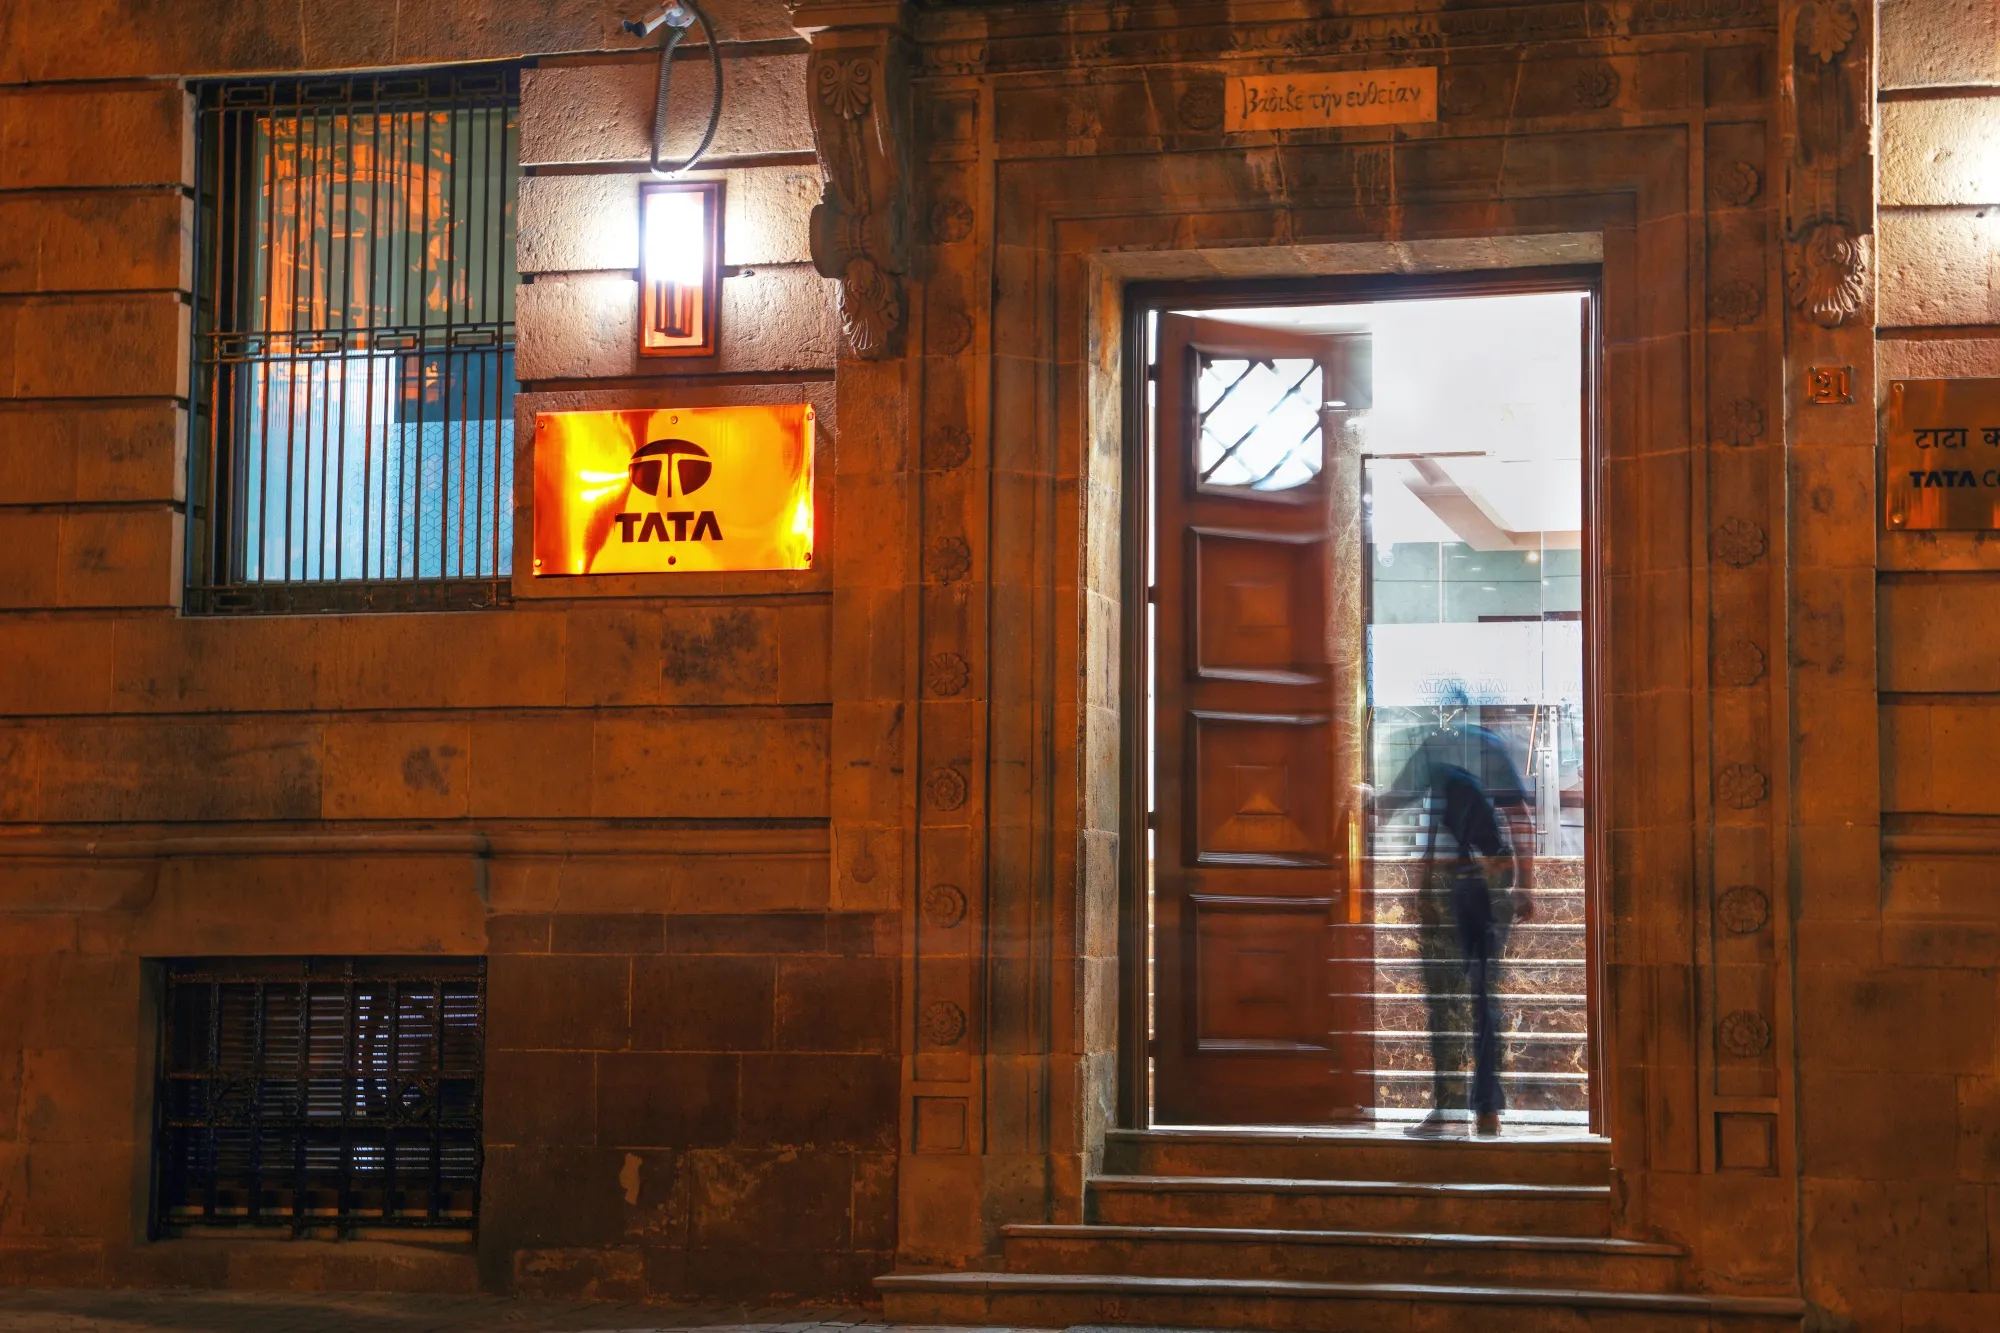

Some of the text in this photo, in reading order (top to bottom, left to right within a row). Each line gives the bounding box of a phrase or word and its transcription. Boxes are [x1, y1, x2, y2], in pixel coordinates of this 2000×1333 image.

[1815, 371, 1847, 397] 21
[1913, 428, 1969, 449] टाटा
[1909, 470, 2000, 488] TATA C
[615, 511, 723, 543] TATA
